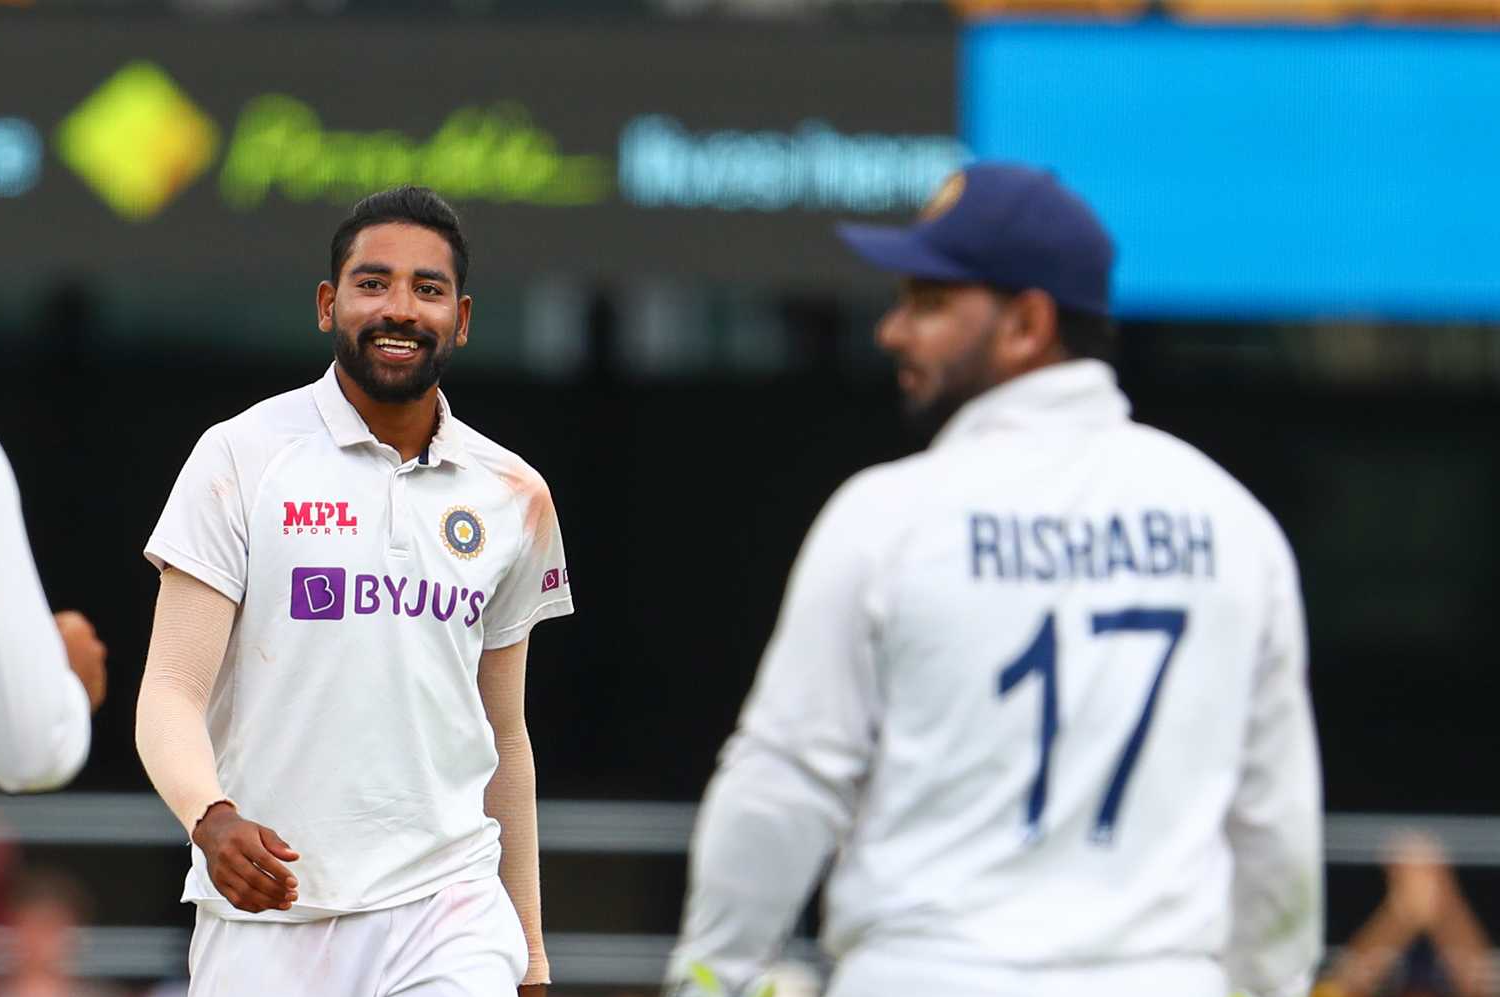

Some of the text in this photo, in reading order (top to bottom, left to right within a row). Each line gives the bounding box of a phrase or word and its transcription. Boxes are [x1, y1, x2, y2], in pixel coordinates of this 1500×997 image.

[283, 502, 357, 527] MPL
[283, 527, 357, 535] SPORTS
[969, 510, 1218, 583] RISHABH
[354, 574, 485, 629] BYJU'S
[996, 608, 1190, 846] 17
